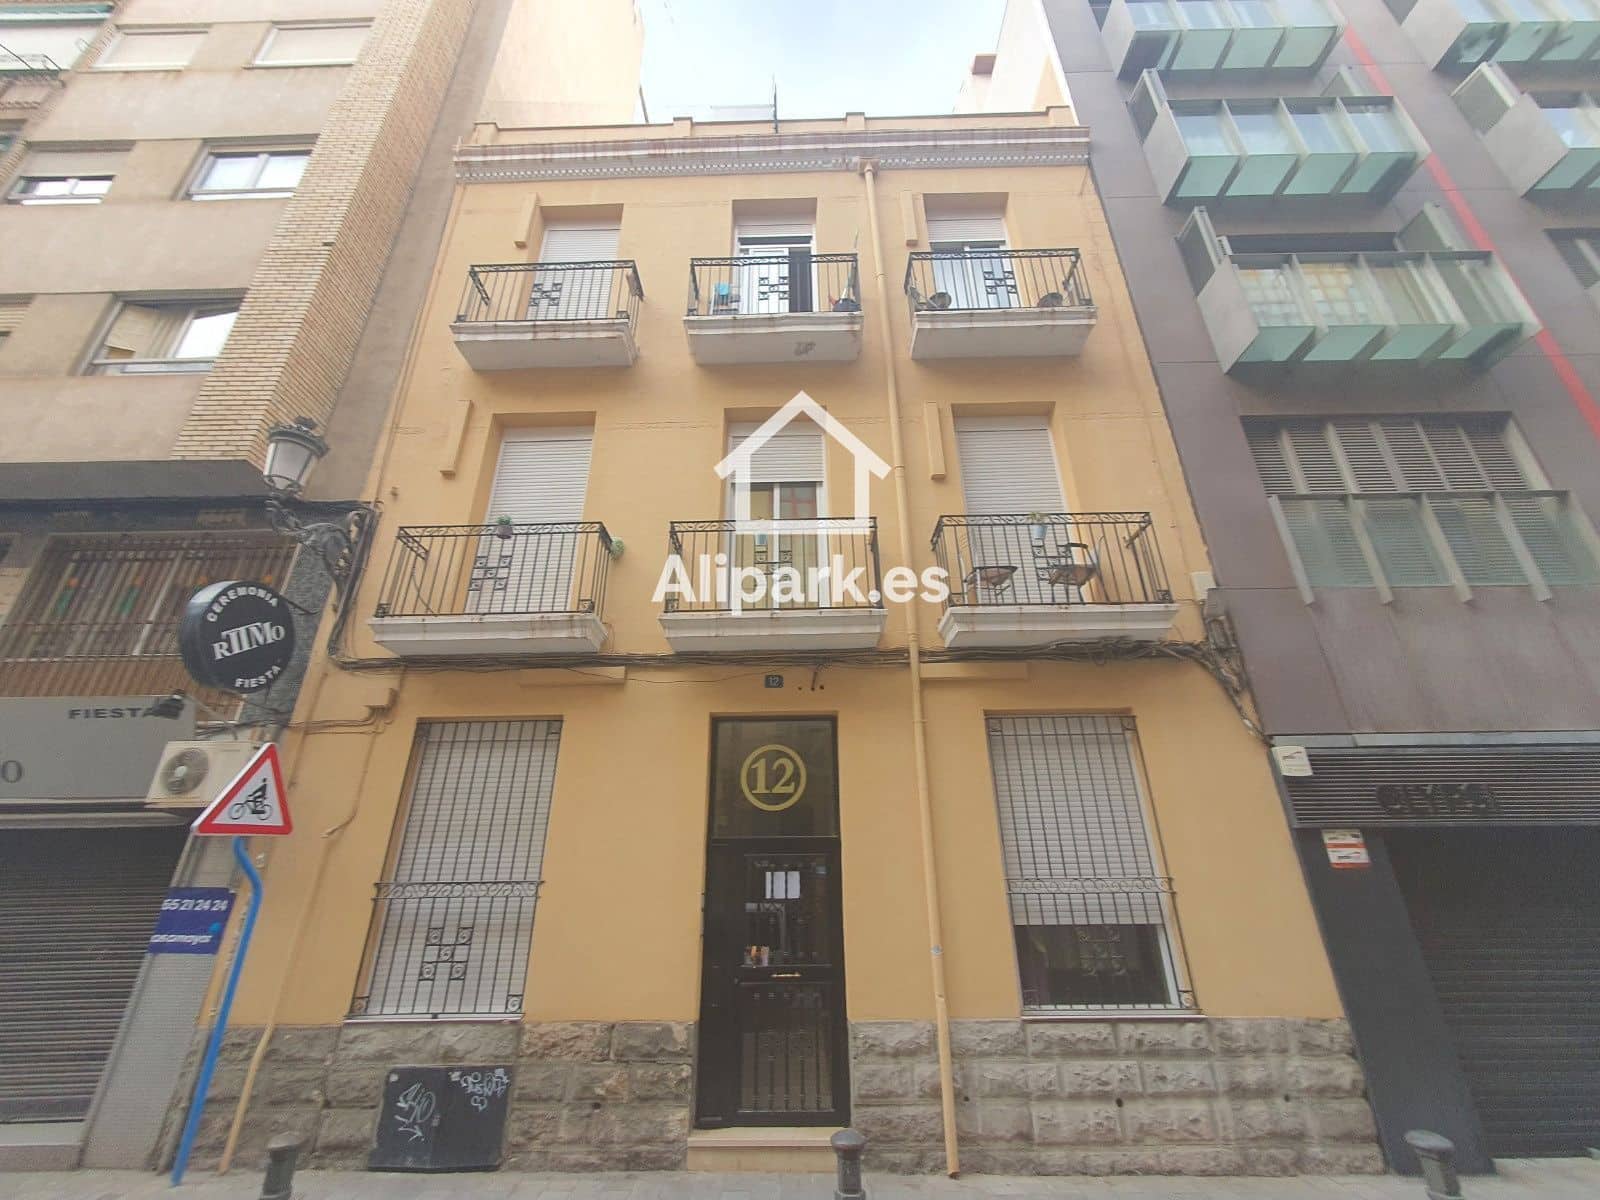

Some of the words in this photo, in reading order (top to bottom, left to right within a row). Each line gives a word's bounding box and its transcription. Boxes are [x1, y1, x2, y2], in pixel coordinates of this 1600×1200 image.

[206, 586, 278, 622] CEREMONIA
[234, 665, 281, 688] FIESTA
[68, 707, 157, 720] FIESTA
[751, 757, 796, 794] 12
[193, 899, 213, 911] 24
[210, 899, 229, 911] 24
